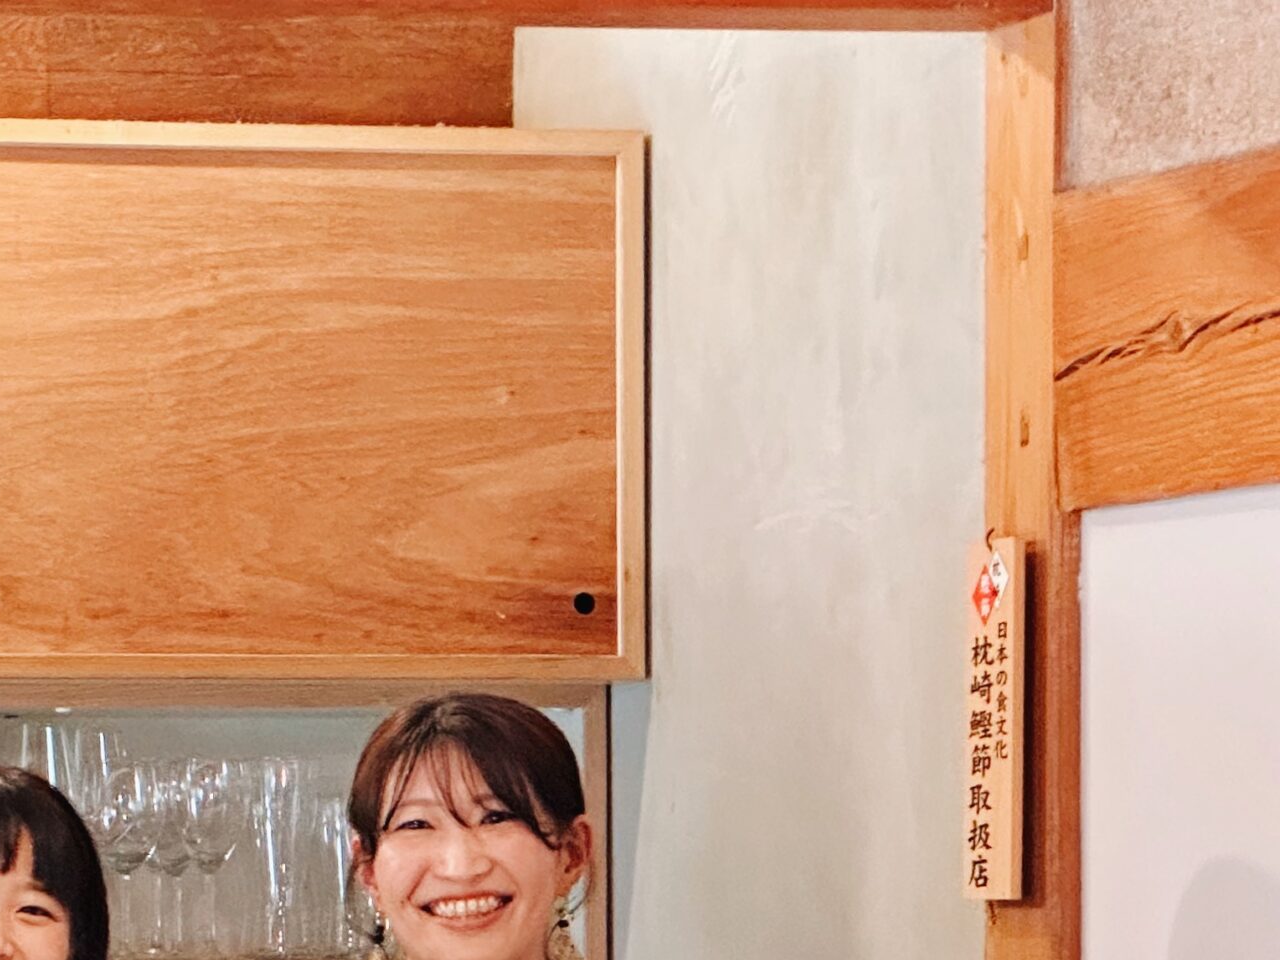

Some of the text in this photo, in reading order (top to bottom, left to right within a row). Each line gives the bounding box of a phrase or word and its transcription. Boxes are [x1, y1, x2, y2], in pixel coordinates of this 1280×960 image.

[968, 637, 995, 888] 枕崎鰹節取扱店
[994, 621, 1008, 760] 日本の食文化
